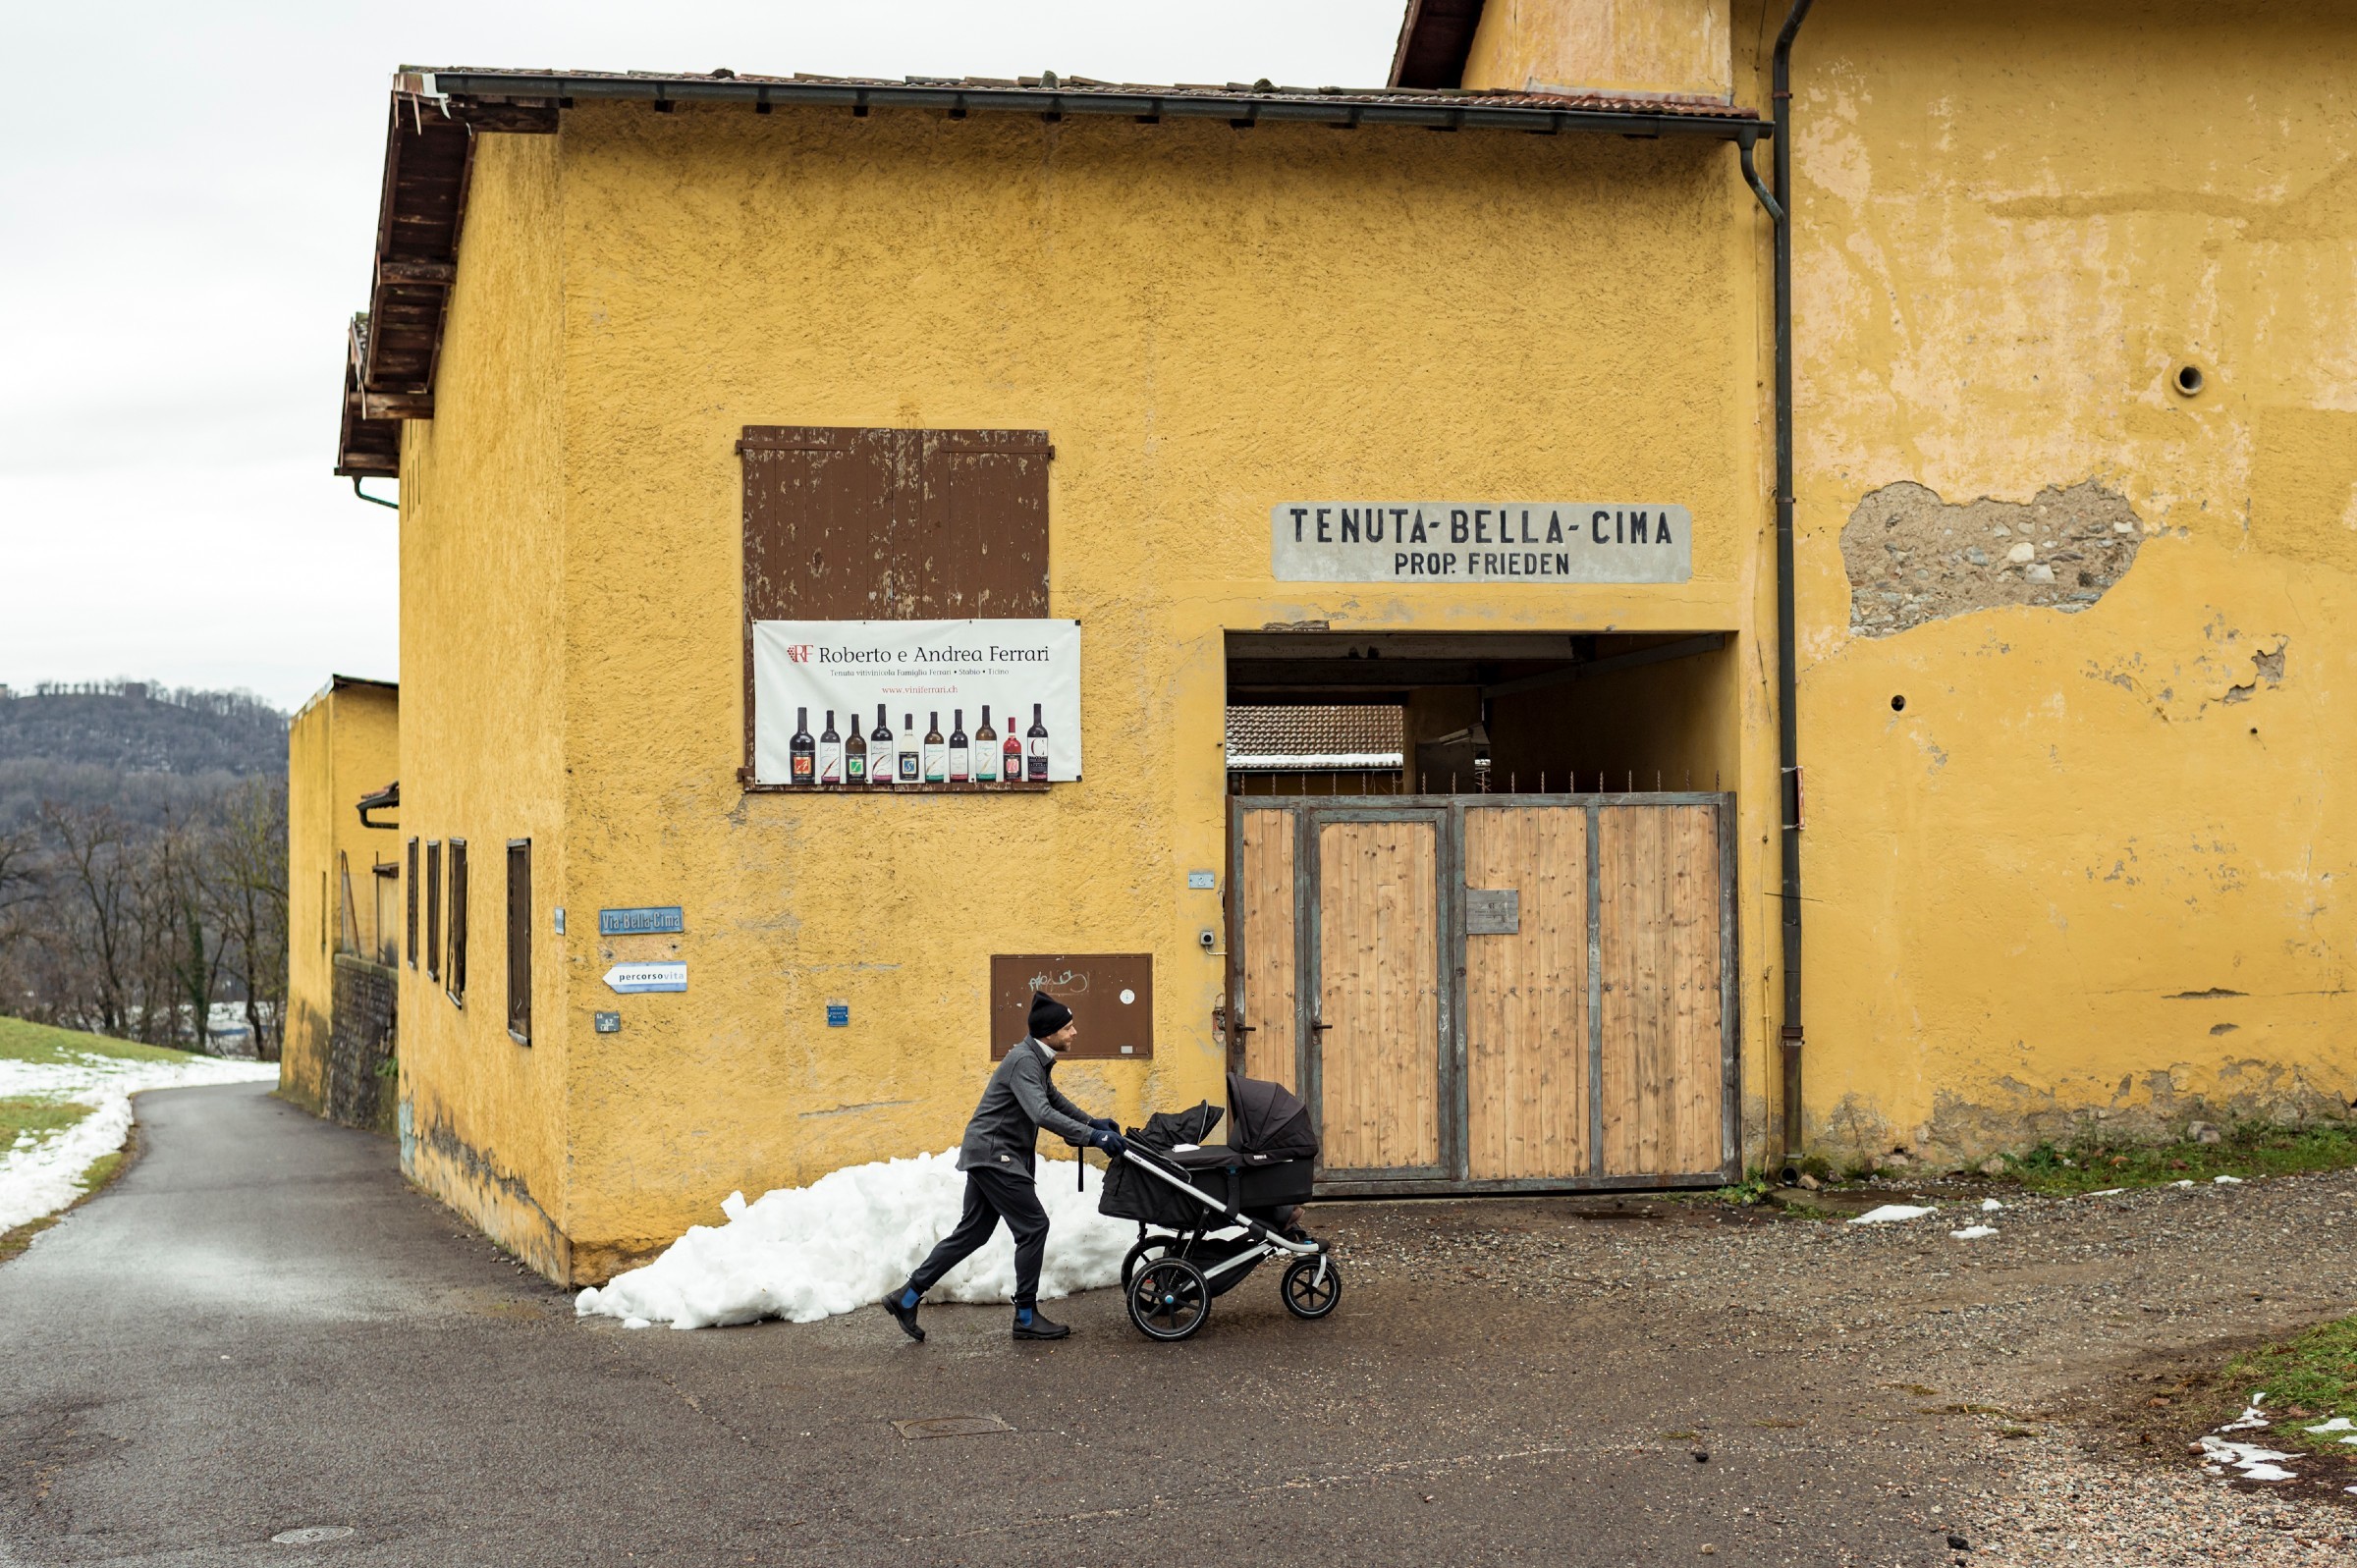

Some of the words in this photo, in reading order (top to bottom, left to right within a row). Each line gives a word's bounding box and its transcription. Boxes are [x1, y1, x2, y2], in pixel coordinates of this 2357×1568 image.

[1395, 552, 1456, 575] PROP.
[1468, 553, 1569, 575] FRIEDEN
[819, 646, 892, 663] Roberto
[898, 650, 907, 663] e
[913, 645, 983, 663] Andrea
[989, 645, 1050, 662] Ferrari
[897, 668, 927, 677] Famiglia
[881, 685, 959, 694] www.viniferrari.ch
[1197, 875, 1205, 886] 2
[619, 970, 685, 983] percorsovita
